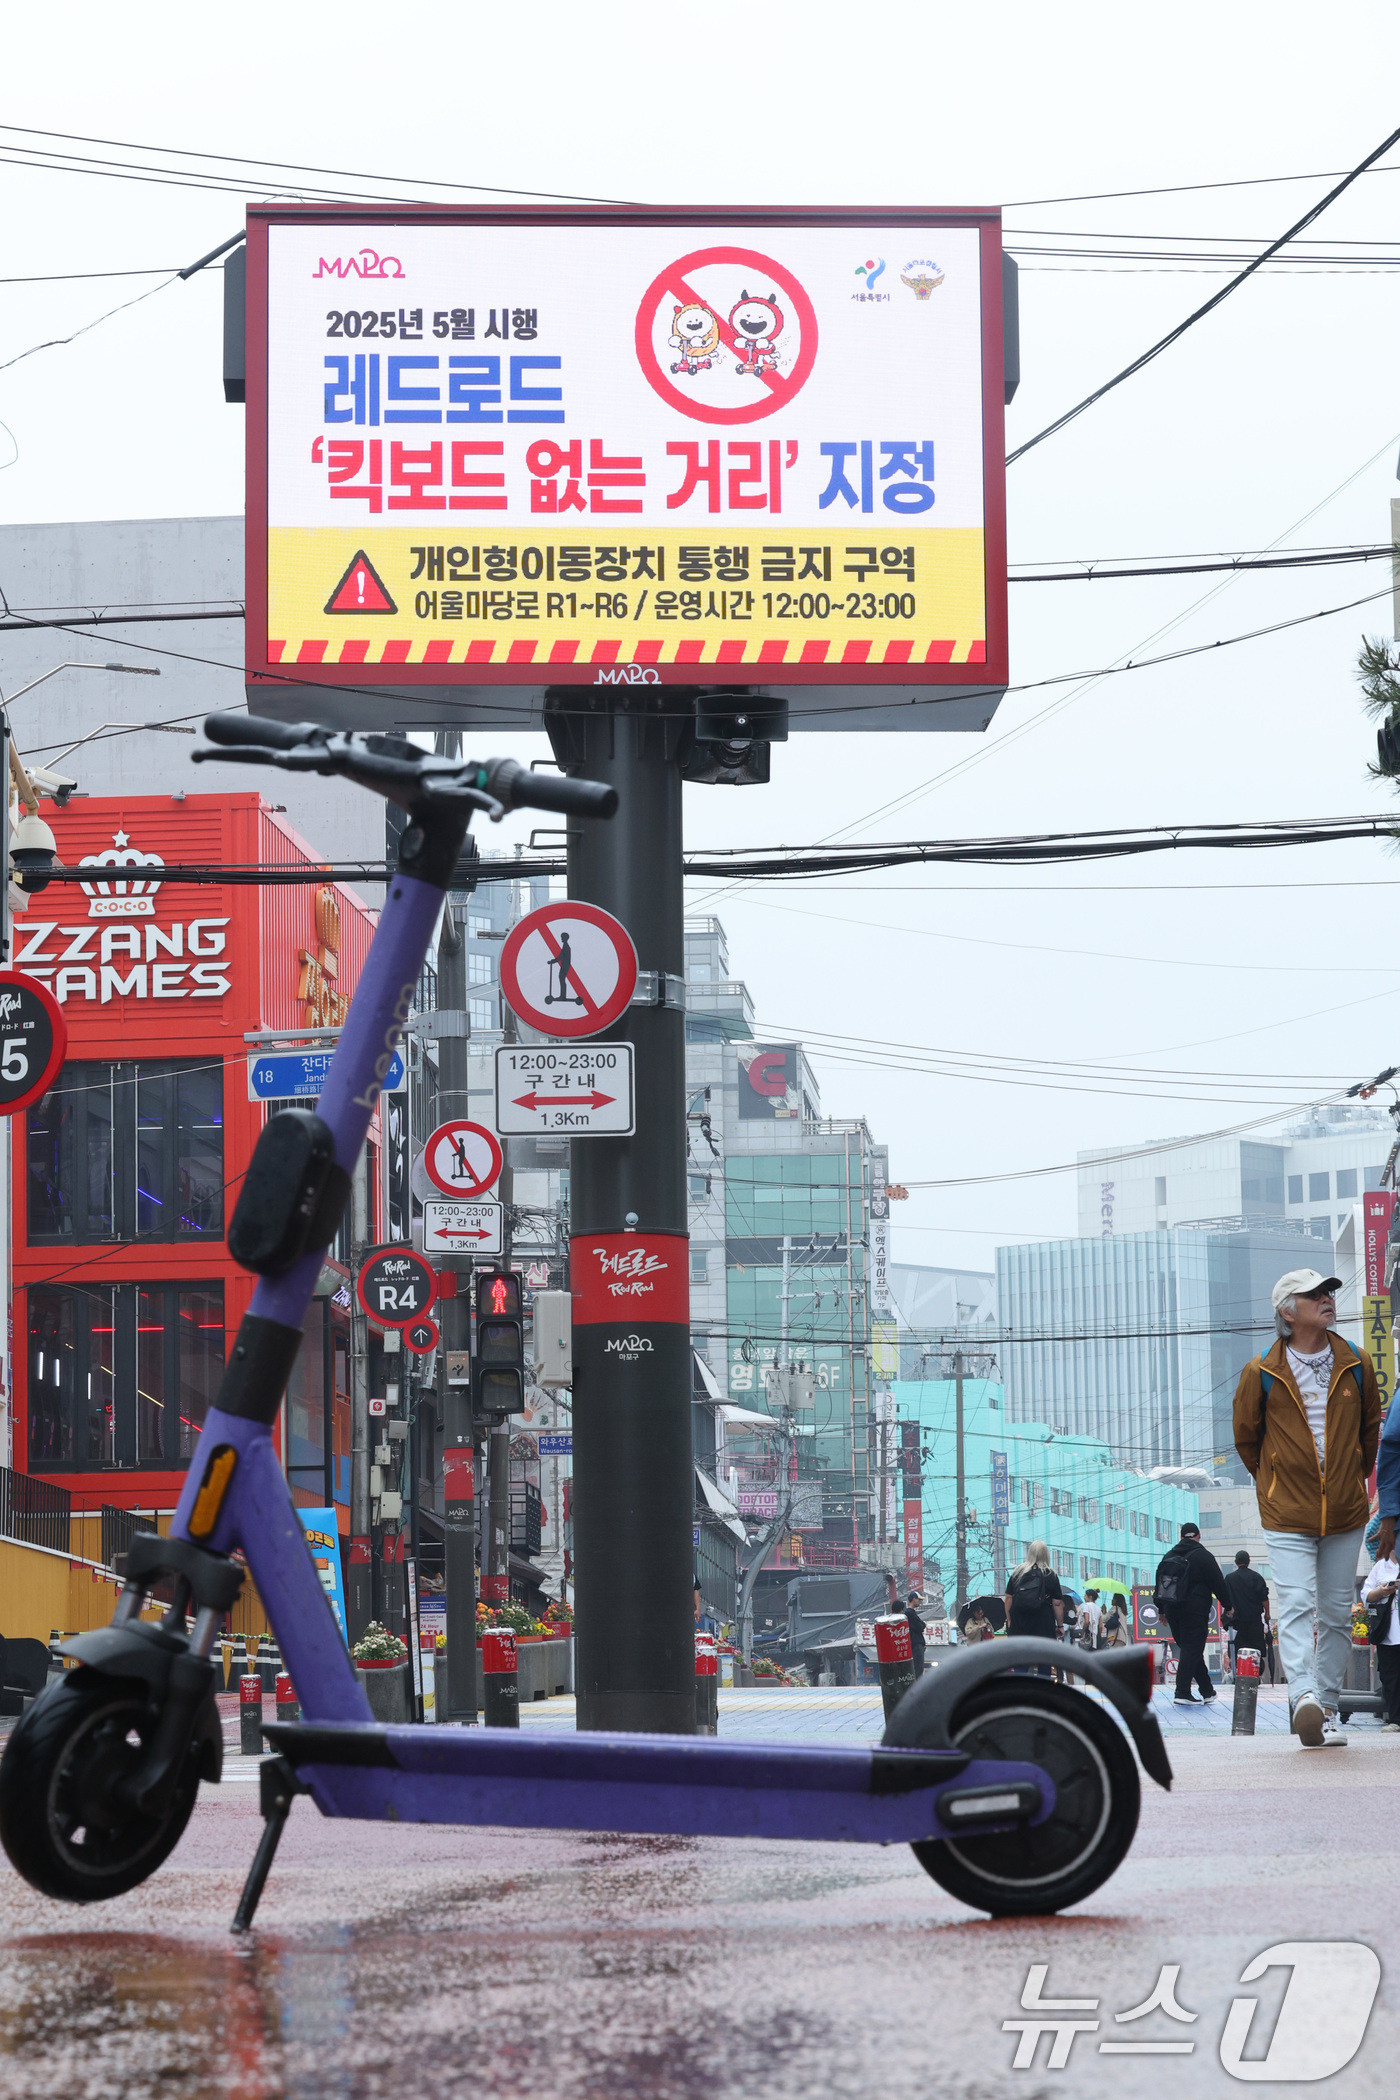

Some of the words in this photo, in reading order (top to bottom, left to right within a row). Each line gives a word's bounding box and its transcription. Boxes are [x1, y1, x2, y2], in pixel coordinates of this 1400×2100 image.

[312, 248, 406, 278] MAPO
[851, 293, 890, 302] 서울특별시
[327, 309, 424, 341] 2025년
[433, 309, 476, 341] 5월
[485, 308, 538, 341] 시행
[324, 355, 565, 426] 레드로드
[526, 439, 646, 514] 없는
[820, 440, 935, 514] 지정
[411, 546, 665, 582] 개인형이동장치
[678, 546, 750, 582] 통행
[761, 547, 832, 582] 금지
[844, 547, 915, 583] 구역
[416, 591, 540, 621] 어울마당로
[547, 593, 628, 619] R1~R6
[634, 590, 648, 621] /
[655, 591, 755, 621] 운영시간
[763, 593, 916, 620] 12:00~23:00
[593, 664, 662, 685] MAPO
[13, 918, 231, 964] ZZANG
[1, 1037, 29, 1082] 5
[509, 1054, 617, 1070] 12:00~23:00
[258, 1070, 274, 1084] 18
[541, 1112, 590, 1128] 1.3Km
[432, 1206, 494, 1217] 12:00~23:00
[1367, 1229, 1377, 1262] HOLLYS
[593, 1249, 668, 1278] 레드로드
[875, 1236, 886, 1288] 엑스케이프
[608, 1282, 630, 1297] Red
[631, 1282, 654, 1297] Road
[1369, 1263, 1379, 1296] COFFEE
[379, 1285, 418, 1310] R4
[604, 1335, 654, 1352] MAPO
[1370, 1300, 1389, 1411] TATTOO
[818, 1363, 840, 1388] 6F
[540, 1437, 573, 1447] 와우산로
[995, 1468, 1008, 1524] 호미화방
